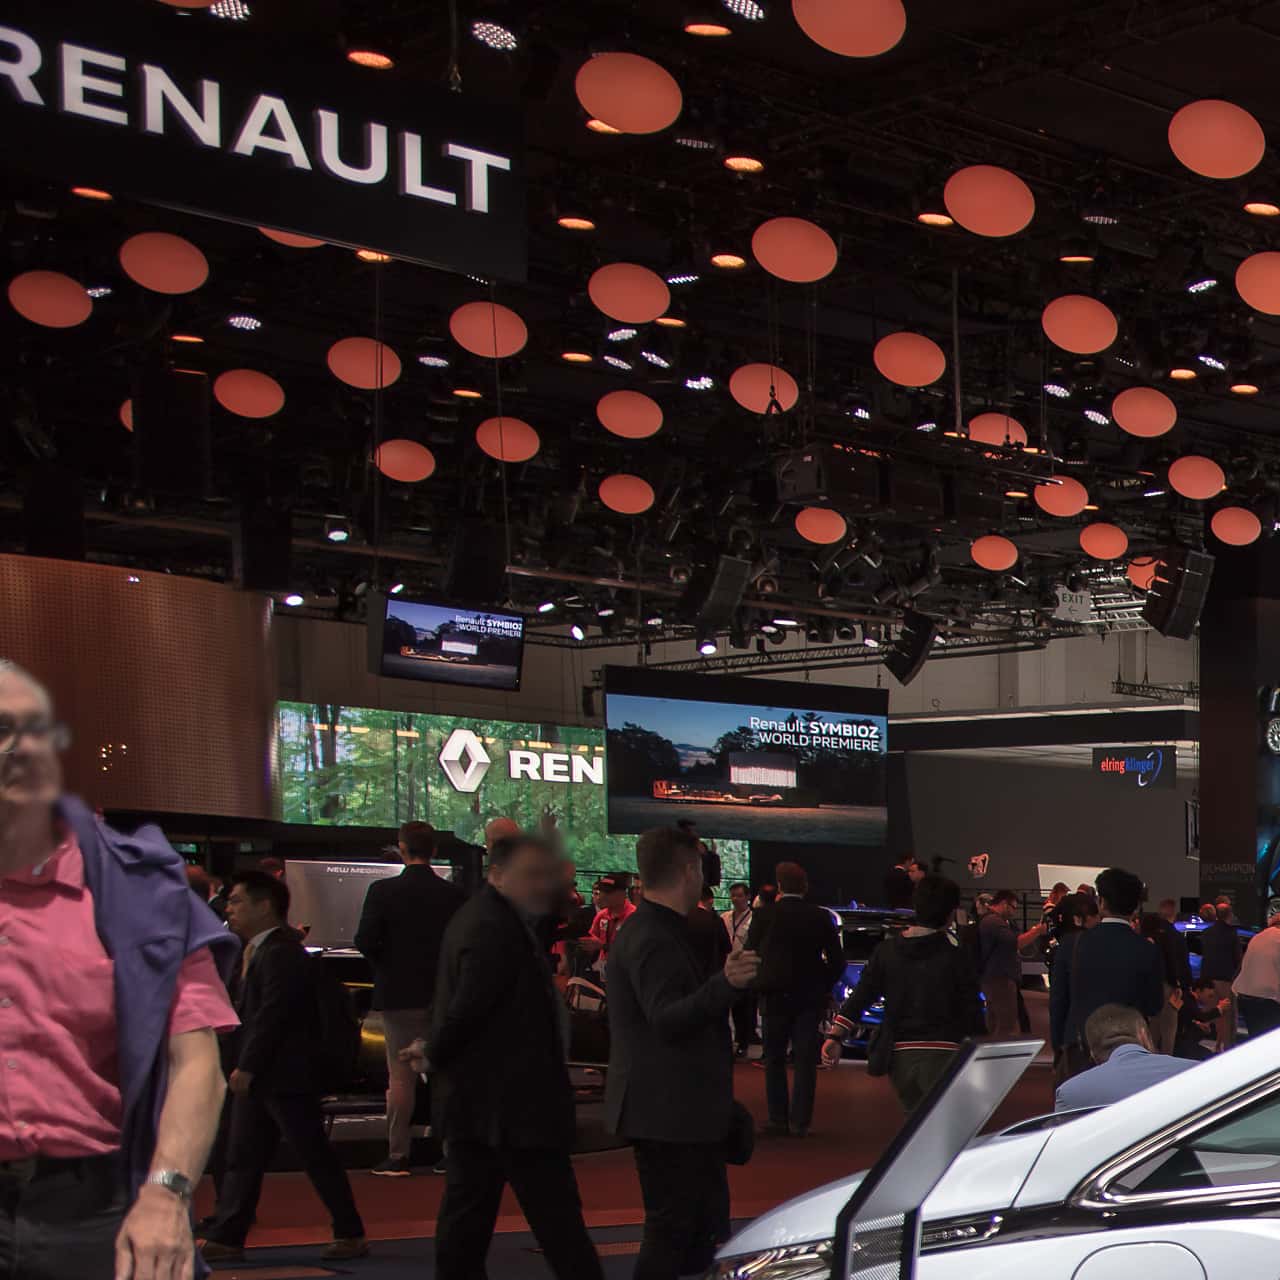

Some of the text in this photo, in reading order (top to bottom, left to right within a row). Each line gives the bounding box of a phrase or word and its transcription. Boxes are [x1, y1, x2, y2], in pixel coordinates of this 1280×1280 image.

[0, 25, 511, 214] RENAULT
[457, 624, 487, 634] WORLD
[749, 716, 880, 739] Renault SYMBIOZ
[758, 731, 880, 752] WORLD PREMIERE
